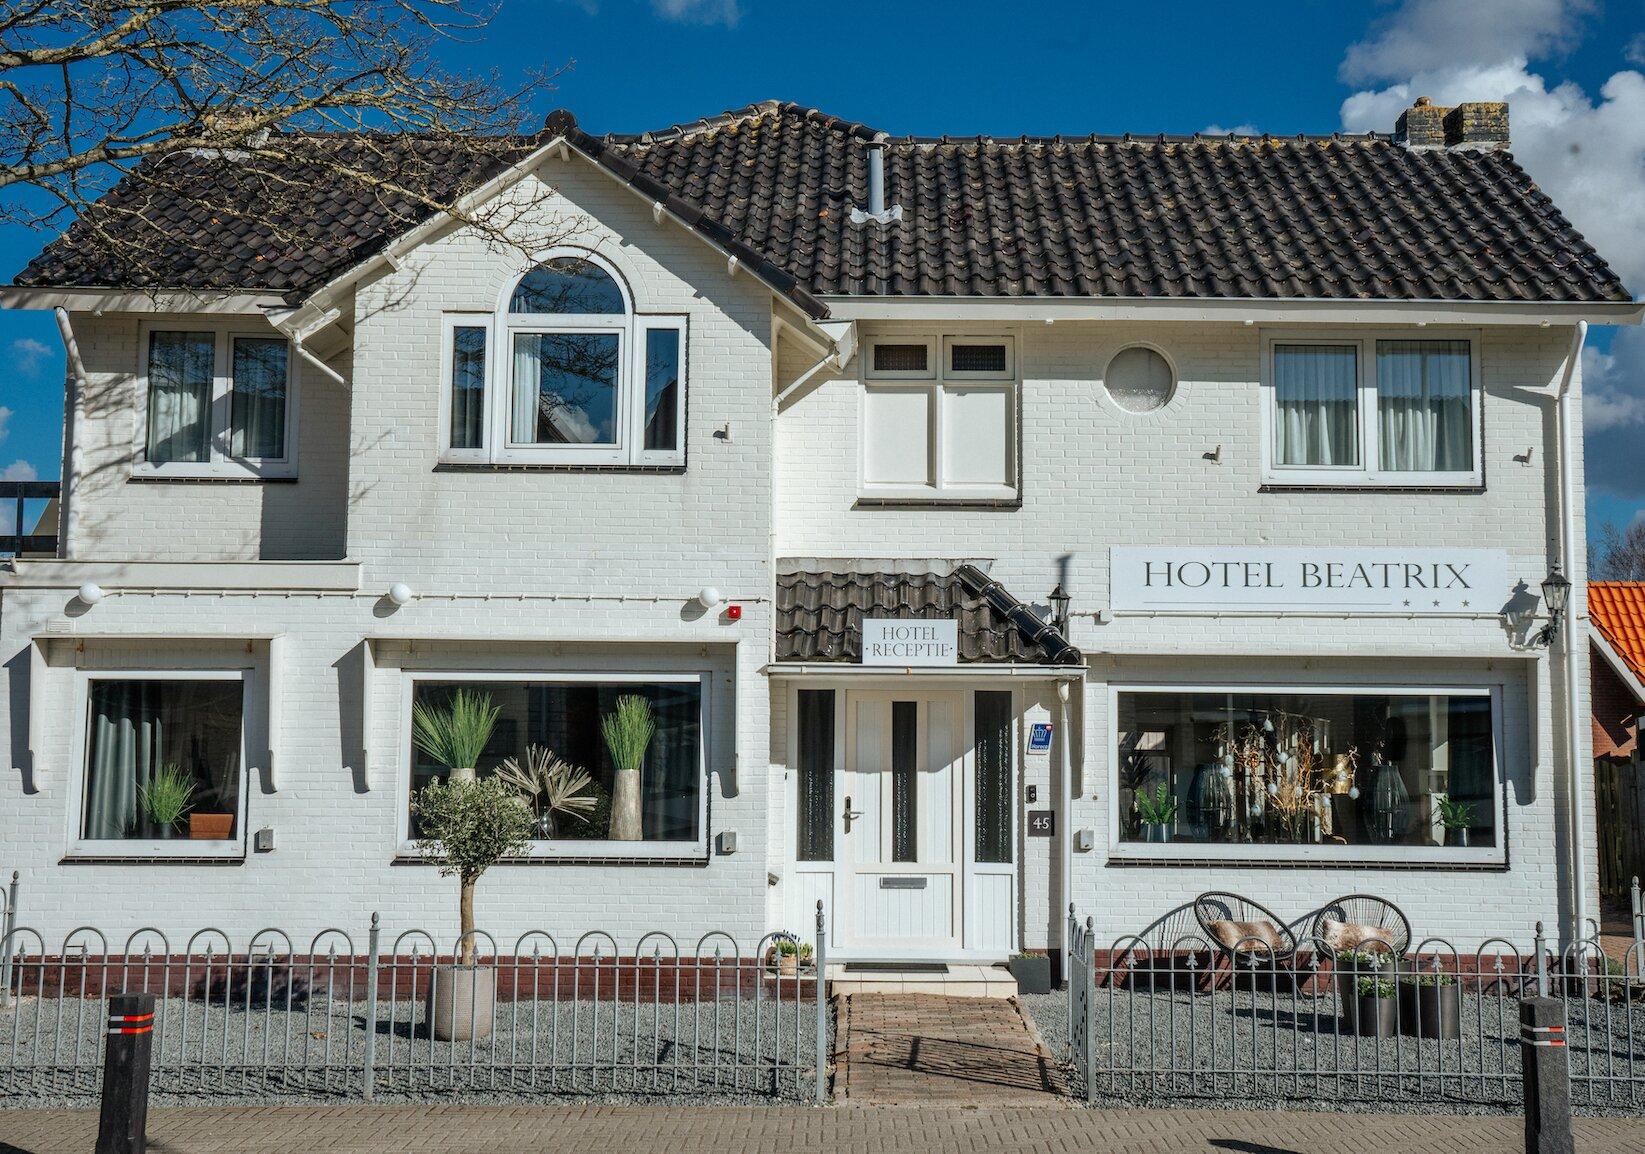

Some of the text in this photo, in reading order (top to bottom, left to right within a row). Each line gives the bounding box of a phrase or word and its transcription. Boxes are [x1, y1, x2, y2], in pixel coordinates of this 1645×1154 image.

[1143, 561, 1471, 589] HOTEL BEATRIX
[882, 626, 940, 640] HOTEL
[872, 643, 949, 657] RECEPTIE
[1033, 816, 1050, 830] 45
